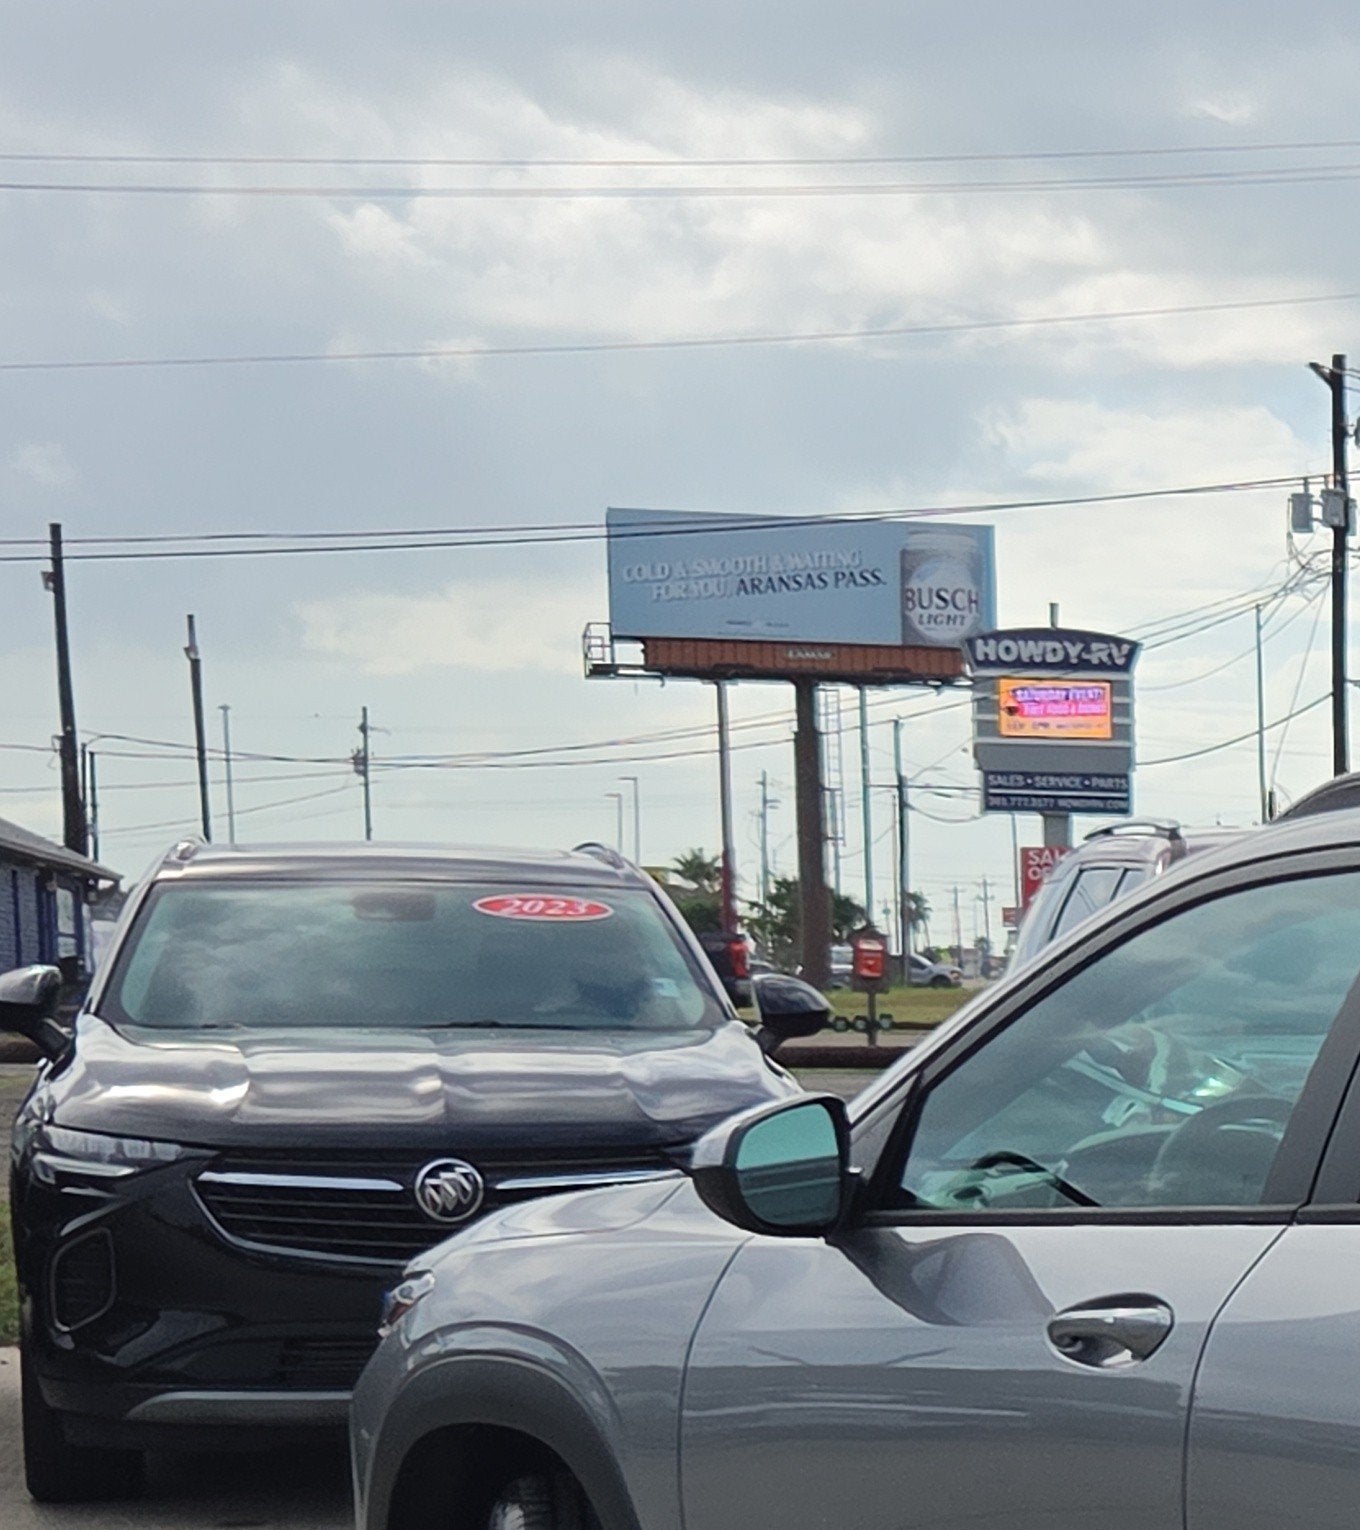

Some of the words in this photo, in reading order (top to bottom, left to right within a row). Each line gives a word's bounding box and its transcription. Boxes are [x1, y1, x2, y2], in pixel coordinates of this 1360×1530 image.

[623, 564, 671, 582] COLD
[736, 572, 828, 596] ARANSAS
[905, 587, 979, 614] BUSCH
[918, 613, 966, 626] LIGHT
[975, 638, 1084, 664] HOWDY
